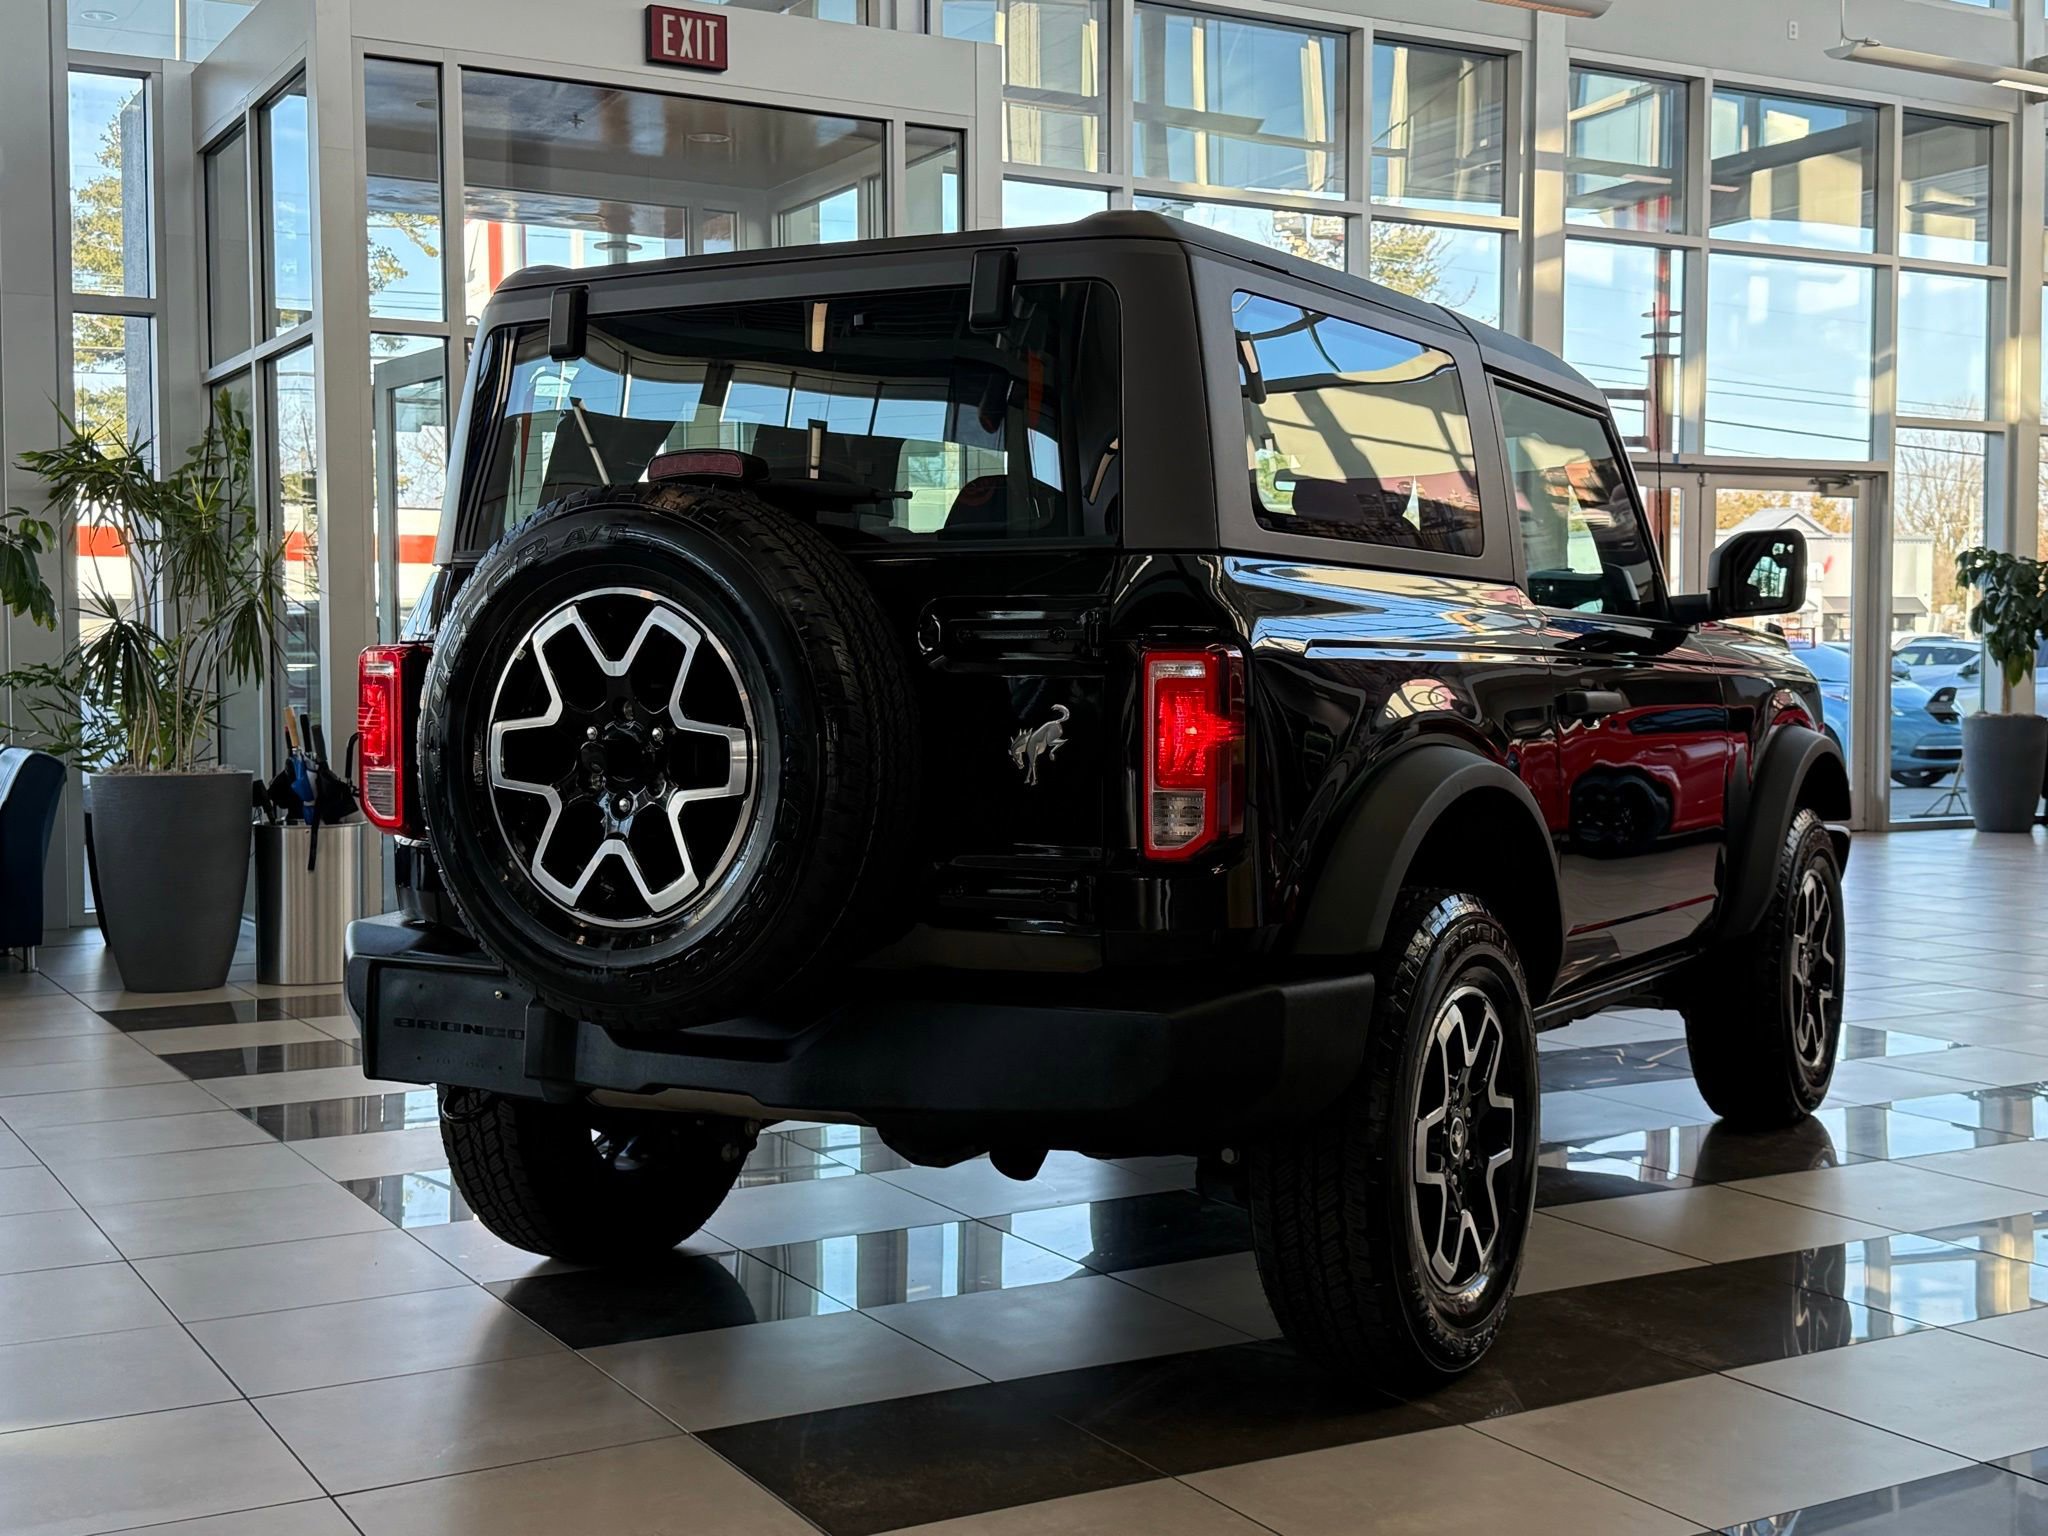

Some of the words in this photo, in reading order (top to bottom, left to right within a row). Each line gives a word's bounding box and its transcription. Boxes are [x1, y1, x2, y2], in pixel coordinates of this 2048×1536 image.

[662, 14, 718, 62] EXIT
[561, 523, 629, 551] A/T
[393, 1017, 526, 1041] BRONCO
